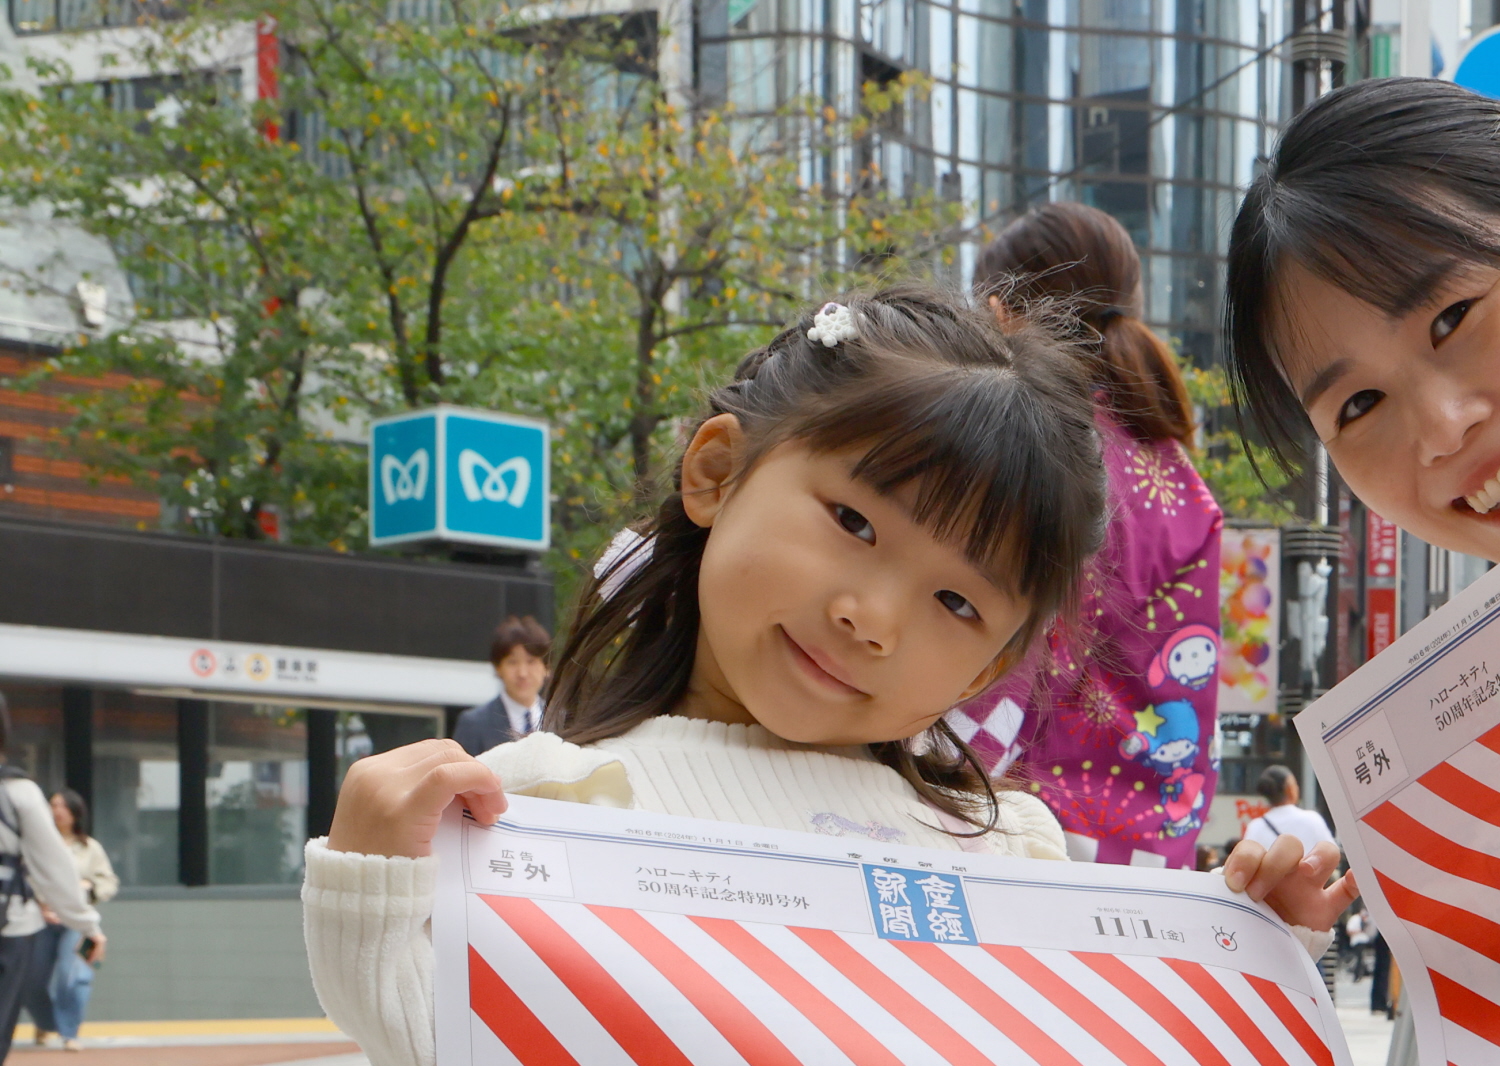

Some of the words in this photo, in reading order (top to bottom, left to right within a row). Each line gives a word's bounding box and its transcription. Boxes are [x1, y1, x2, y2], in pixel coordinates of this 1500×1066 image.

[1429, 661, 1489, 710] ハローキティ
[1356, 739, 1376, 760] 広告
[1354, 748, 1391, 786] 号外
[501, 849, 534, 862] 広告
[488, 859, 551, 882] 号外
[635, 866, 732, 885] ハローキティ
[638, 880, 811, 910] 50周年記念特別号外
